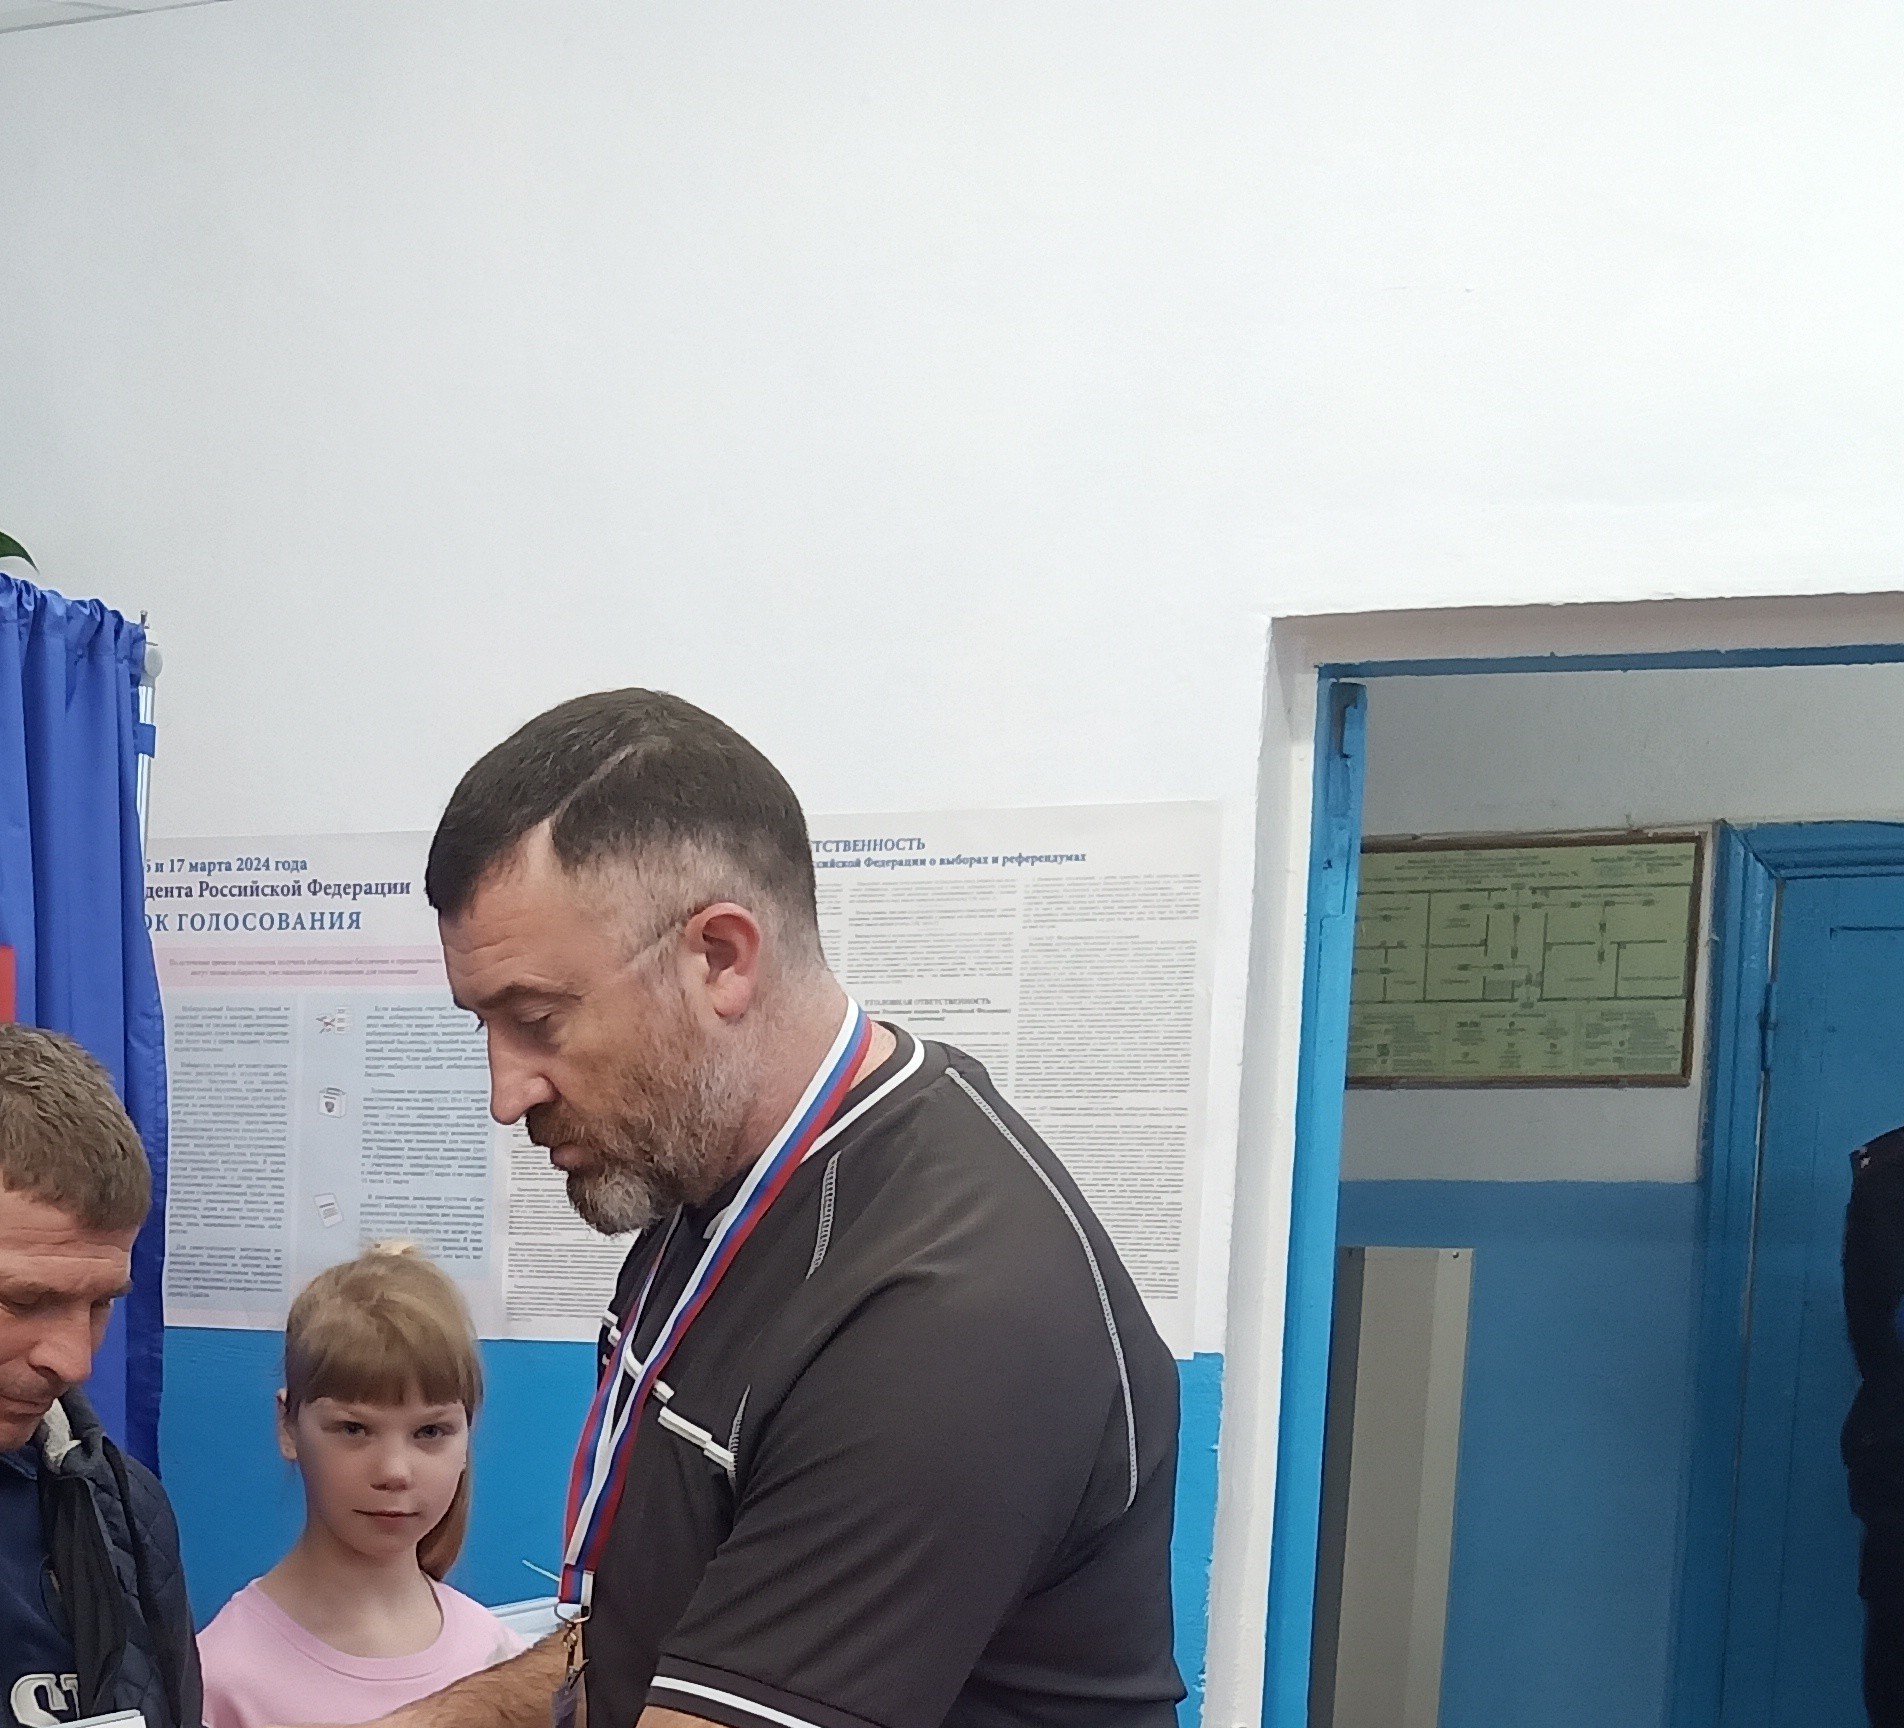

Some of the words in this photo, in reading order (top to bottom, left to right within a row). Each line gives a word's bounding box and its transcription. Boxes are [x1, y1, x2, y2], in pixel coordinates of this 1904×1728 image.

[811, 838, 925, 852] ТСТВЕННОСТЬ
[154, 863, 164, 873] и
[169, 859, 185, 873] 17
[188, 861, 232, 876] марта
[236, 857, 270, 872] 2024
[275, 859, 308, 873] года
[864, 857, 926, 870] Федерации
[939, 854, 988, 868] выборах
[992, 856, 999, 864] и
[1002, 852, 1086, 867] референдумах
[198, 880, 302, 899] Российской
[307, 879, 411, 901] Федерации
[177, 911, 362, 932] ГОЛОСОВАНИЯ
